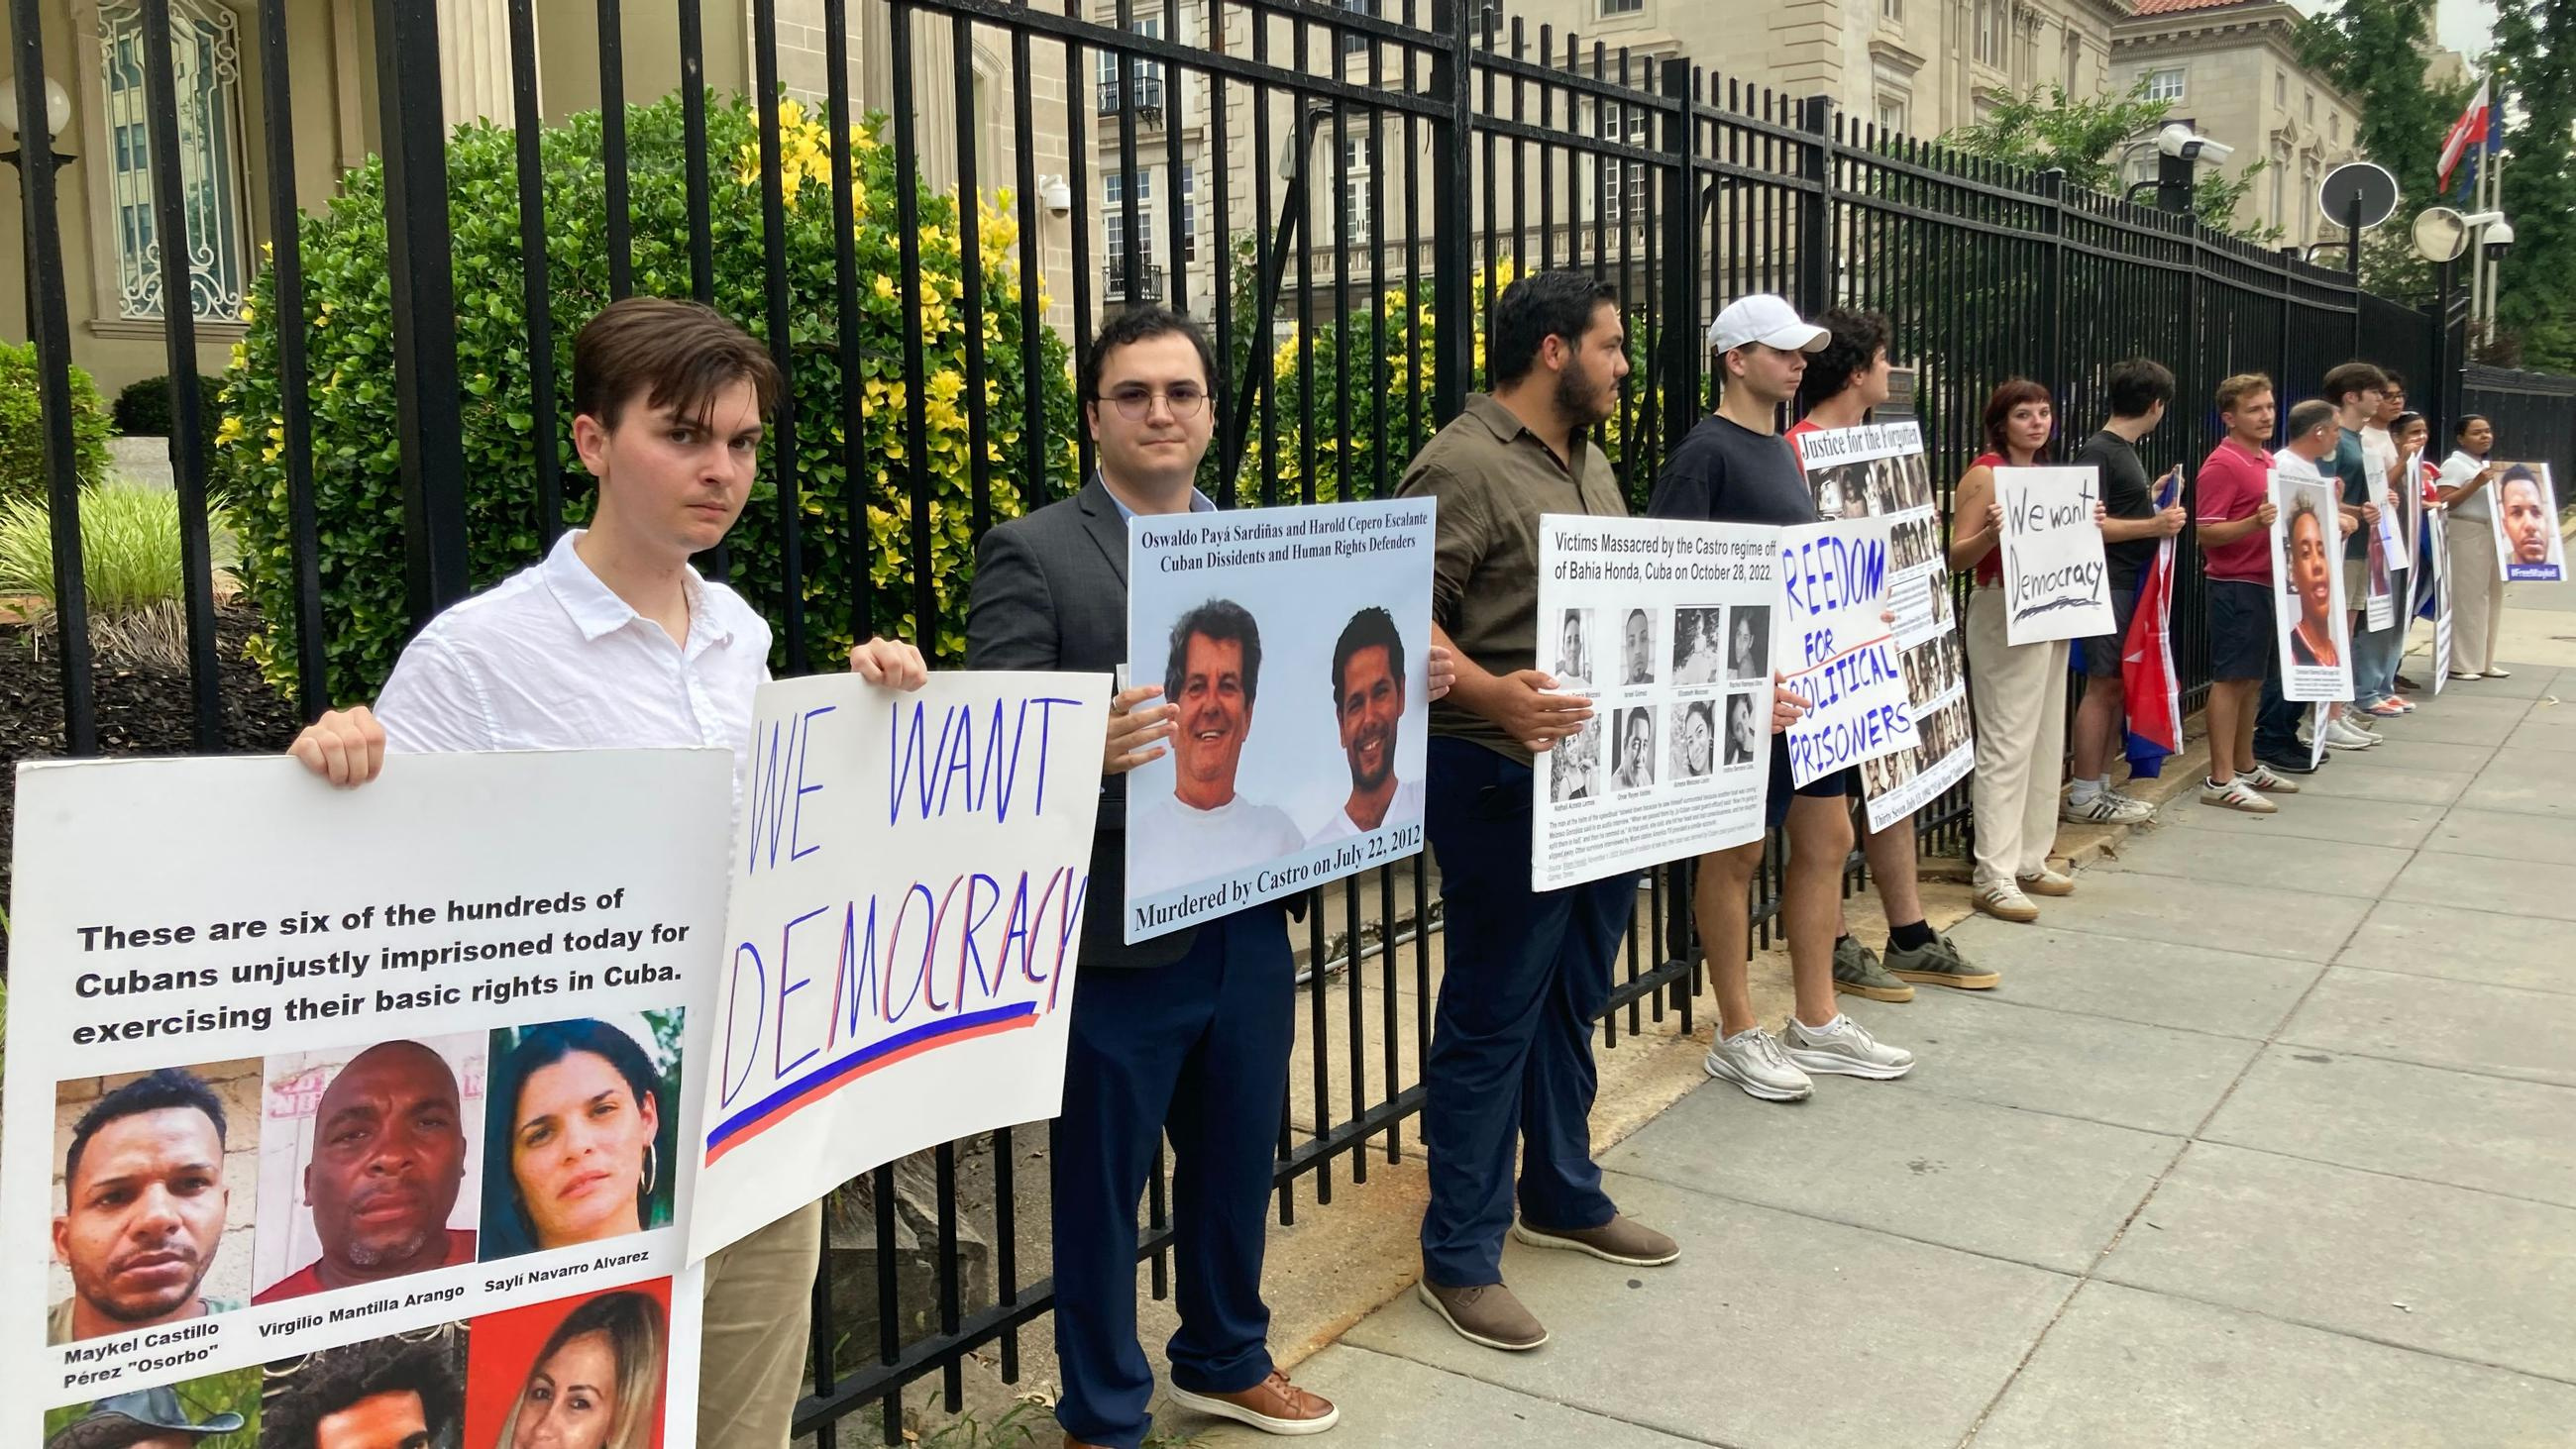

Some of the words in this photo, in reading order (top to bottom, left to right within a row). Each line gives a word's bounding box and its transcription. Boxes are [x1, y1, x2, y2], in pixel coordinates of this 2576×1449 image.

[1801, 431, 1845, 460] Justice
[1847, 428, 1863, 453] for
[1866, 427, 1880, 450] the
[1882, 424, 1919, 452] Forgotten
[1142, 530, 1197, 548] Oswaldo
[1203, 527, 1230, 547] Payá
[1234, 524, 1282, 540] Sardiñas
[1287, 521, 1305, 536] and
[1311, 518, 1344, 534] Harold
[1348, 517, 1382, 534] Cepero
[1385, 511, 1428, 528] Escalante
[2006, 486, 2043, 535] We
[2051, 479, 2094, 527] want
[1161, 556, 1202, 571] Cuban
[1208, 550, 1264, 568] Dissidents
[1269, 546, 1288, 562] and
[1294, 545, 1331, 559] Human
[1336, 539, 1365, 557] Rights
[1370, 535, 1415, 551] Defenders
[1556, 533, 1597, 551] Victims
[1602, 534, 1659, 553] Massacred
[1663, 537, 1673, 558] by
[1677, 538, 1692, 554] the
[1696, 538, 1727, 555] Castro
[1731, 541, 1763, 561] regime
[1765, 540, 1776, 557] off
[1556, 562, 1566, 578] of
[1605, 563, 1642, 582] Honda,
[1646, 563, 1671, 579] Cuba
[1675, 568, 1687, 579] on
[1691, 564, 1730, 579] October
[1733, 565, 1746, 582] 28,
[1750, 565, 1772, 580] 2022.
[1781, 536, 1884, 622] REEDOM
[2010, 545, 2102, 612] Democracy
[1804, 628, 1837, 668] FOR
[1789, 702, 1911, 783] PRISONERS
[749, 706, 836, 876] WE
[891, 697, 1082, 827] WANT
[1136, 885, 1227, 930] Murdered
[1234, 880, 1251, 904] by
[1257, 866, 1308, 892] Castro
[1314, 859, 1330, 876] on
[1334, 845, 1363, 870] July
[1368, 837, 1387, 860] 22,
[1392, 825, 1421, 852] 2012
[77, 926, 195, 951] These
[209, 921, 267, 941] are
[279, 911, 329, 935] six
[342, 906, 375, 929] of
[385, 904, 435, 926] the
[448, 892, 586, 921] hundreds
[596, 888, 624, 909] of
[76, 970, 217, 997] Cubans
[233, 951, 370, 985] unjustly
[382, 933, 552, 971] imprisoned
[564, 928, 642, 952] today
[652, 924, 690, 944] for
[73, 1006, 270, 1044] exercising
[285, 993, 365, 1021] their
[376, 984, 460, 1011] basic
[473, 975, 558, 1003] rights
[570, 971, 592, 990] in
[604, 964, 681, 986] Cuba.
[721, 867, 1089, 1110] DEMOCRACY
[485, 1276, 522, 1292] Saylí
[529, 1264, 589, 1283] Navarro
[593, 1252, 648, 1270] Alvarez
[260, 1315, 322, 1337] Virgilio
[330, 1299, 398, 1322] Mantilla
[405, 1288, 464, 1306] Arango
[65, 1338, 137, 1364] Maykel
[146, 1324, 218, 1347] Castillo
[65, 1368, 121, 1388] Pérez
[129, 1345, 218, 1372] "Osorbo"
